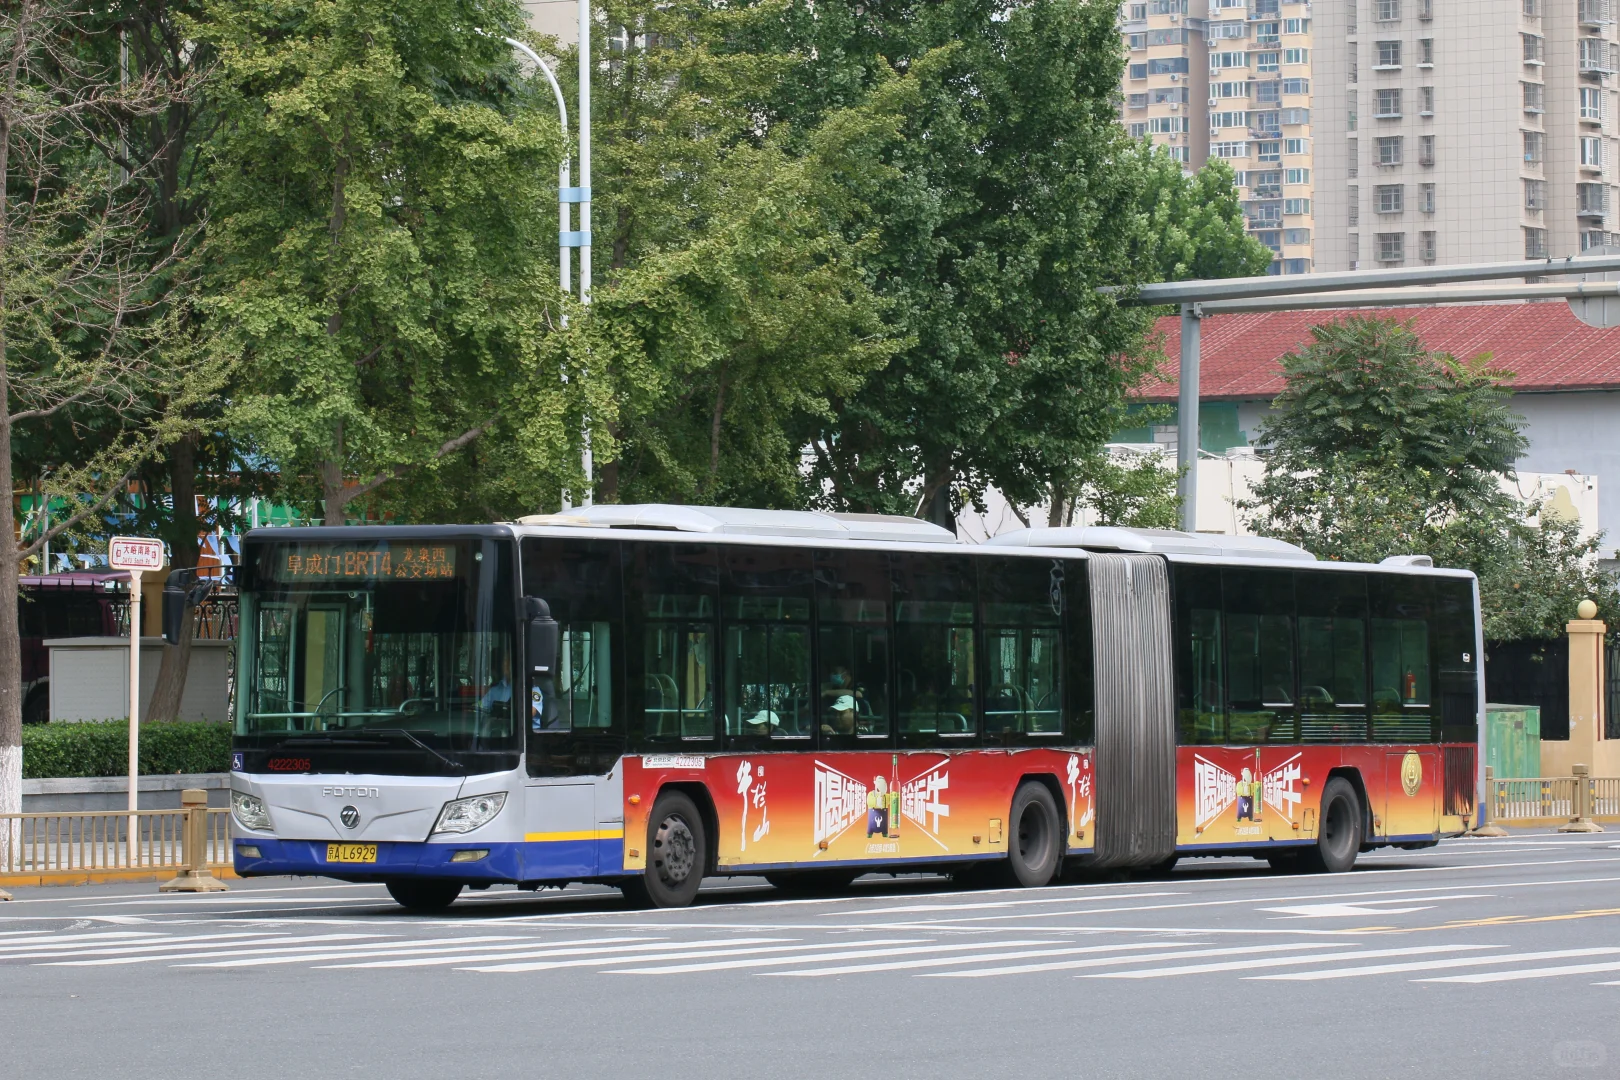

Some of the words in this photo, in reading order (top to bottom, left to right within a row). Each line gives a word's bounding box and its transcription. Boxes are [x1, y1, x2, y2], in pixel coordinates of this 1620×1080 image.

[123, 545, 151, 555] 大峪南路
[403, 548, 445, 563] 龙泉西
[395, 563, 453, 578] 公交场站
[267, 758, 311, 771] 4222305
[675, 756, 703, 767] 4222305
[322, 786, 379, 798] FOTON
